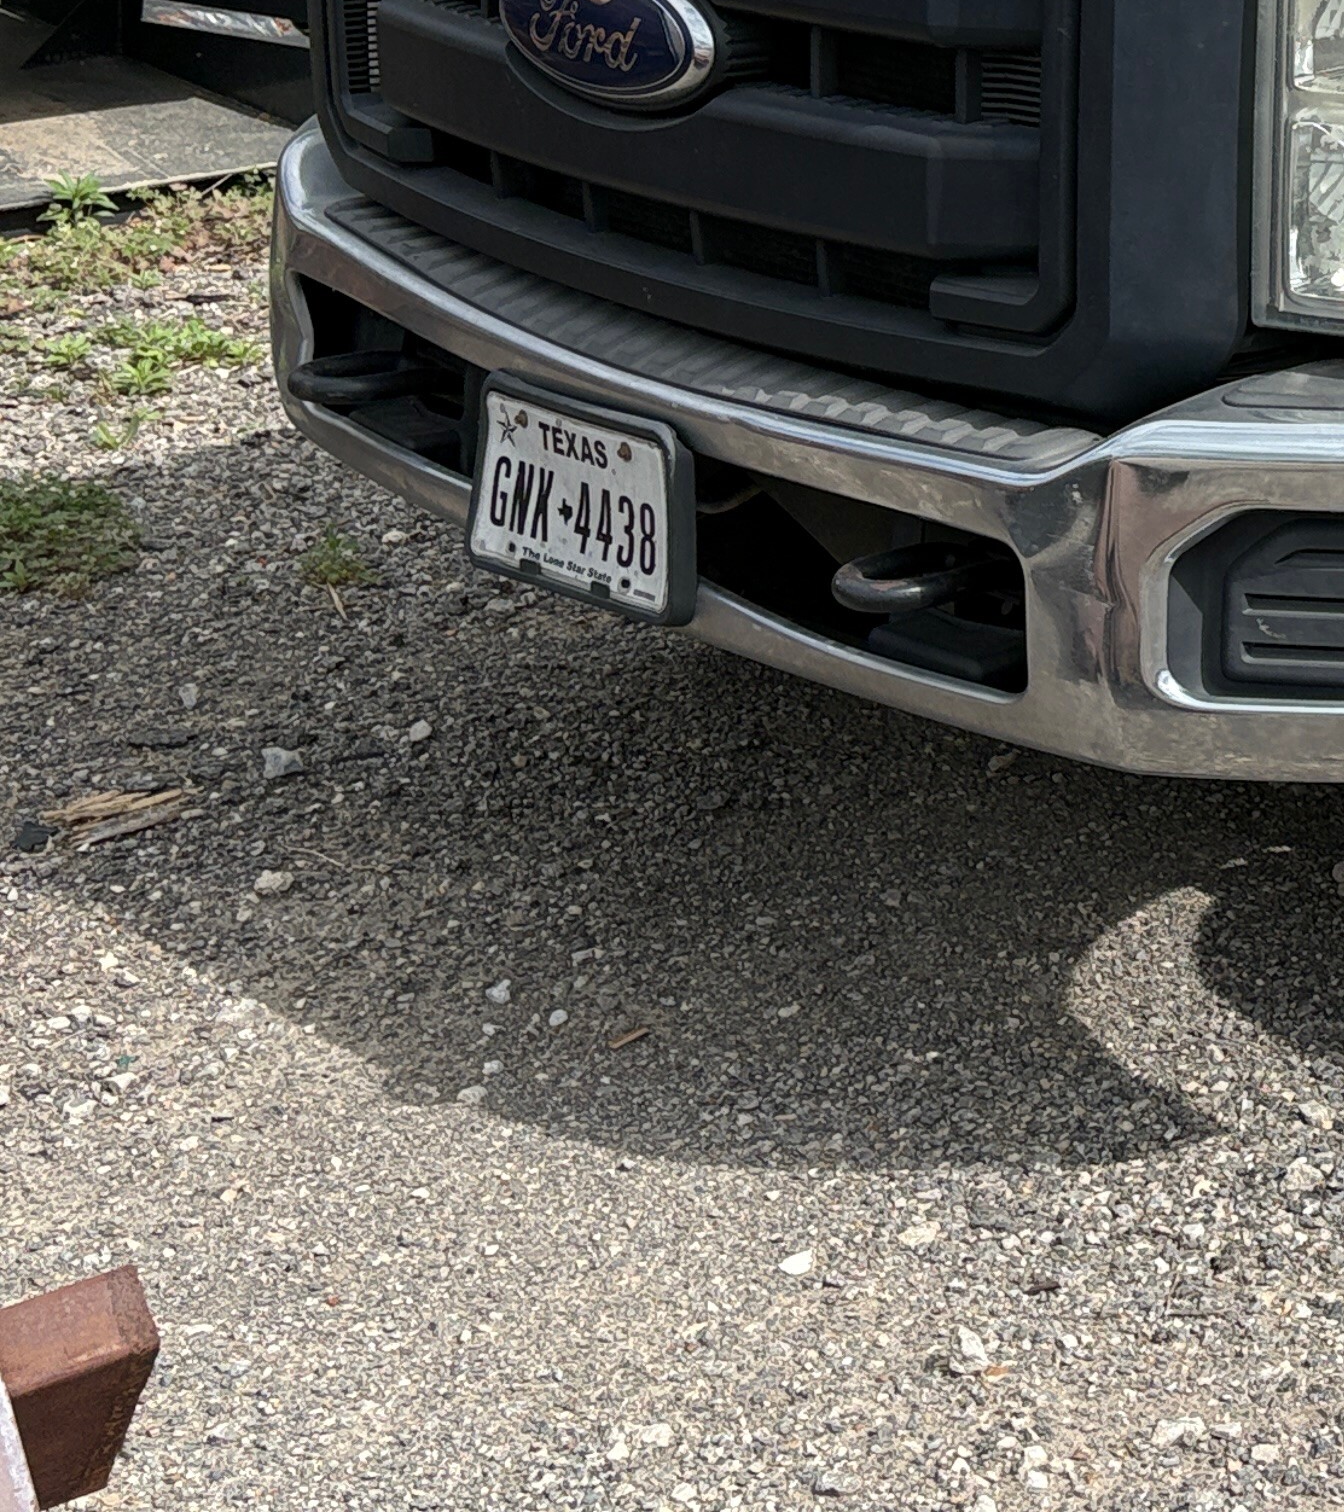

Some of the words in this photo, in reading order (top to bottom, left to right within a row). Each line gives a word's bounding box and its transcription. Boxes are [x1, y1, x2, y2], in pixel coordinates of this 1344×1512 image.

[538, 421, 609, 469] TEXAS
[574, 482, 656, 576] 4438
[522, 546, 541, 561] The
[543, 552, 565, 568] Lone
[566, 560, 587, 576] Star
[587, 566, 612, 583] State
